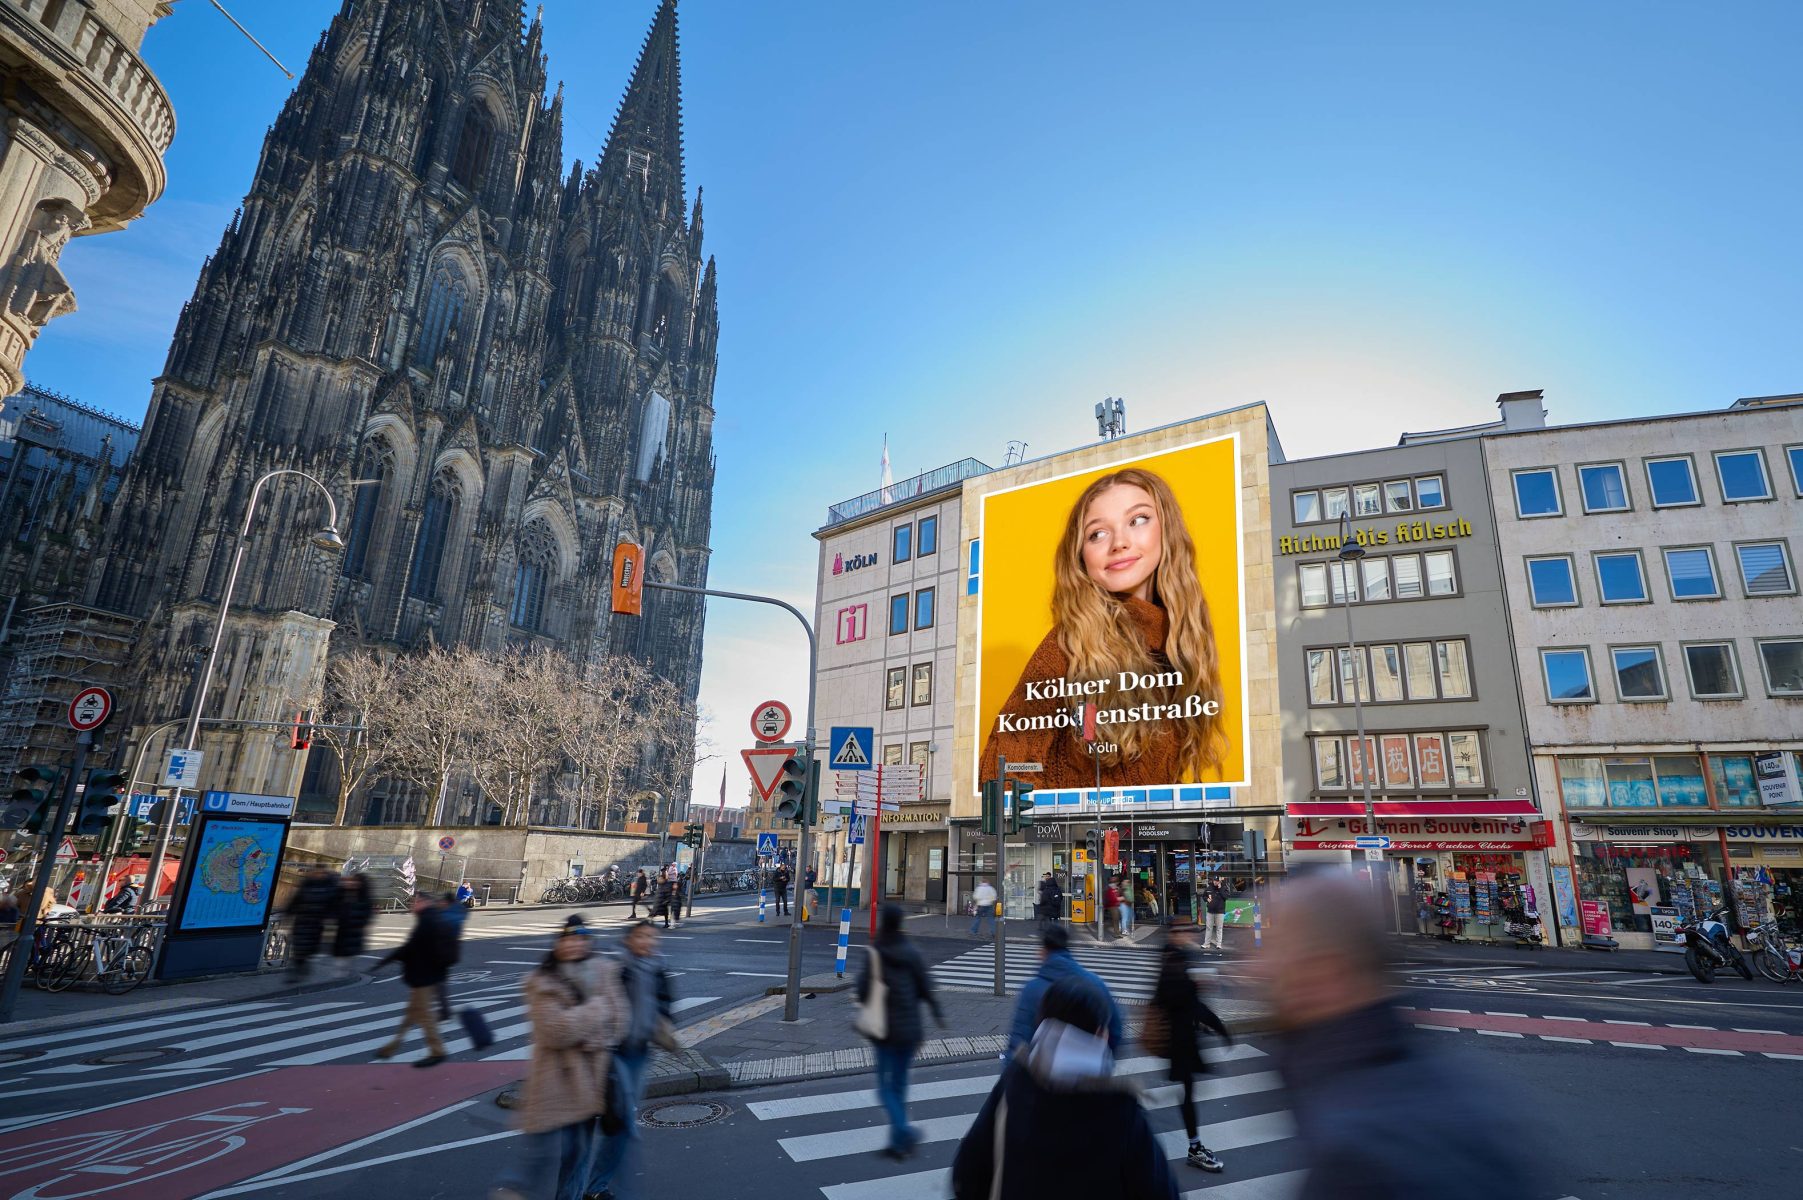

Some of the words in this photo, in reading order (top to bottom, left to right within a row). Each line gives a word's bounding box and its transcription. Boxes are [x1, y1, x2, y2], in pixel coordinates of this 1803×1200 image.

[1396, 517, 1472, 543] Kölsch
[845, 552, 878, 572] KÖLN
[1025, 677, 1110, 701] Kölner
[1117, 671, 1184, 692] Dom
[997, 695, 1219, 733] Komödenstraße
[1763, 783, 1786, 791] SOUVENIR
[208, 793, 225, 809] U
[1608, 825, 1650, 836] Souvenir
[1653, 825, 1678, 837] Shop
[1318, 841, 1357, 849] Origina
[1398, 841, 1432, 849] Forest
[1436, 841, 1475, 849] Cuckoo
[1478, 841, 1513, 849] Clocks
[1654, 920, 1672, 929] 140
